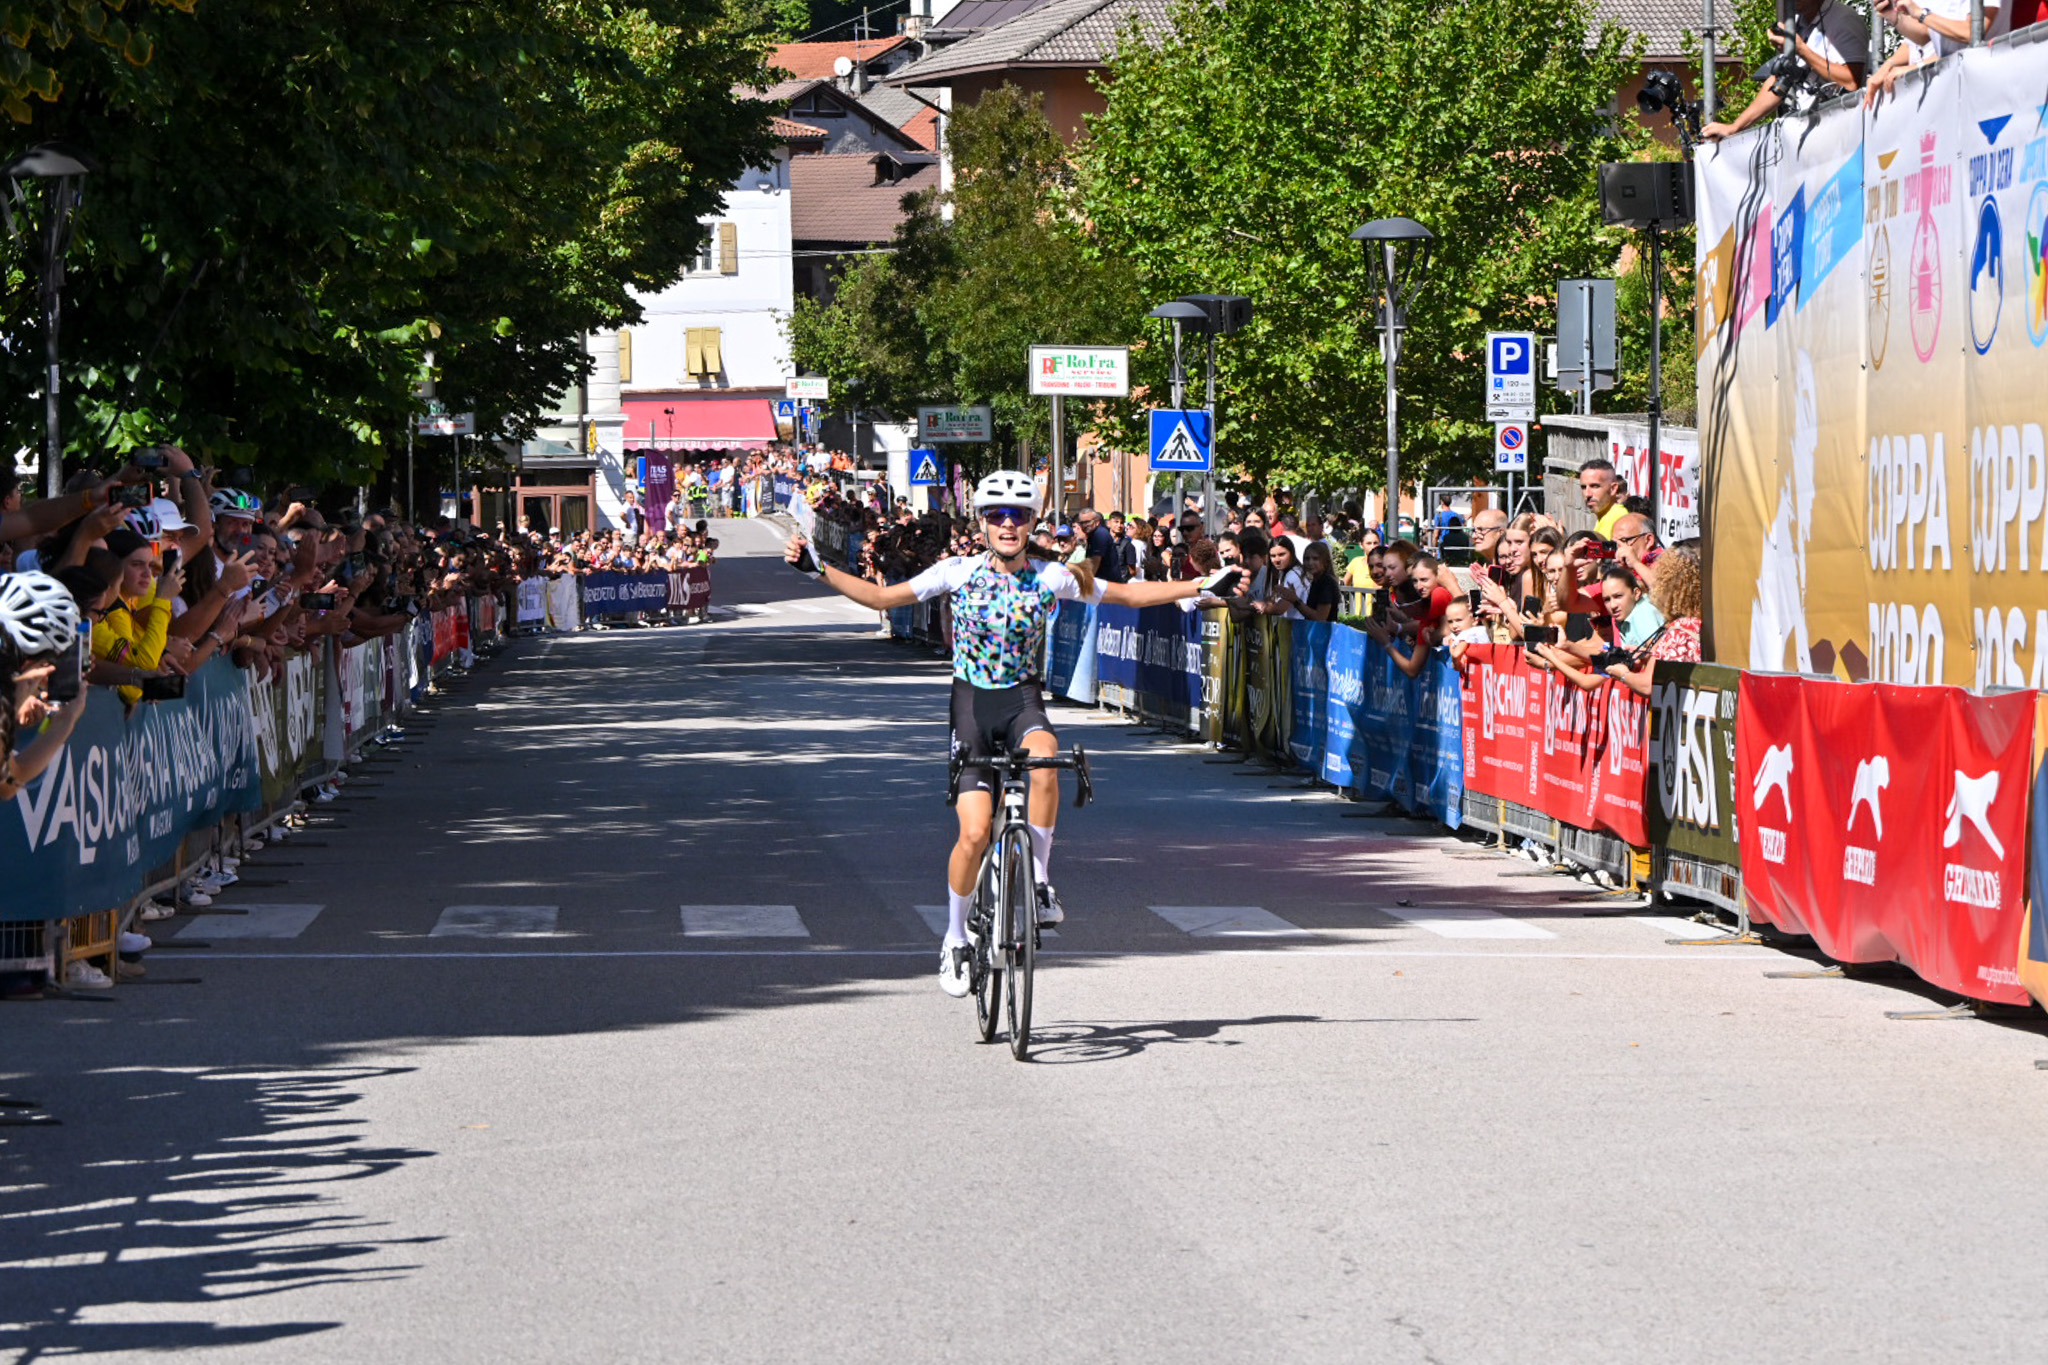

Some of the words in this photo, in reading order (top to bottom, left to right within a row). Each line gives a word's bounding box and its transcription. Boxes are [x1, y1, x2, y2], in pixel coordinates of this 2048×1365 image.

[1500, 341, 1522, 371] P
[1868, 432, 1952, 572] COPPA
[1970, 422, 2048, 574] COPP
[1974, 605, 2048, 697] ROS
